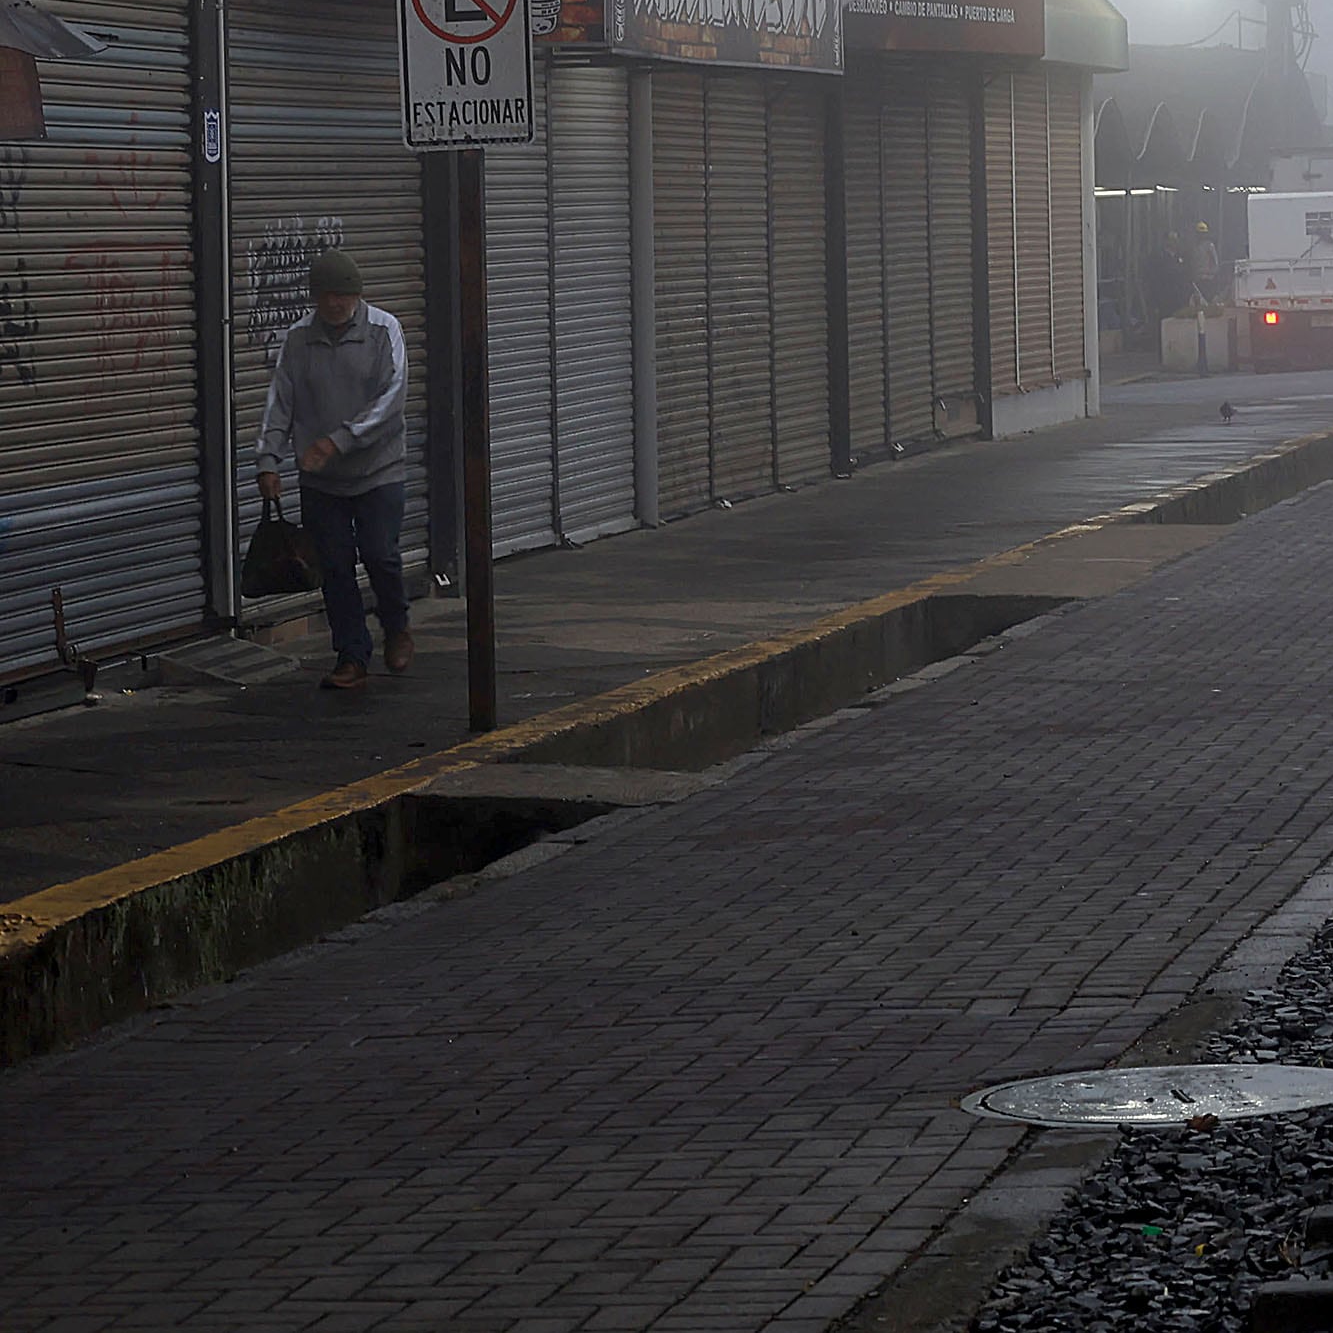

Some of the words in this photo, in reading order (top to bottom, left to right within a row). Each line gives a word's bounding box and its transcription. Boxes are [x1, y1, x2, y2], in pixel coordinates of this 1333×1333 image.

[894, 0, 917, 17] CAMBIO
[917, 1, 926, 17] DE
[926, 2, 959, 19] PANTALLAS
[964, 5, 987, 22] PUERTO
[988, 7, 997, 22] DE
[996, 7, 1016, 23] CARGA
[444, 45, 492, 87] NO
[413, 98, 526, 128] ESTACIONAR
